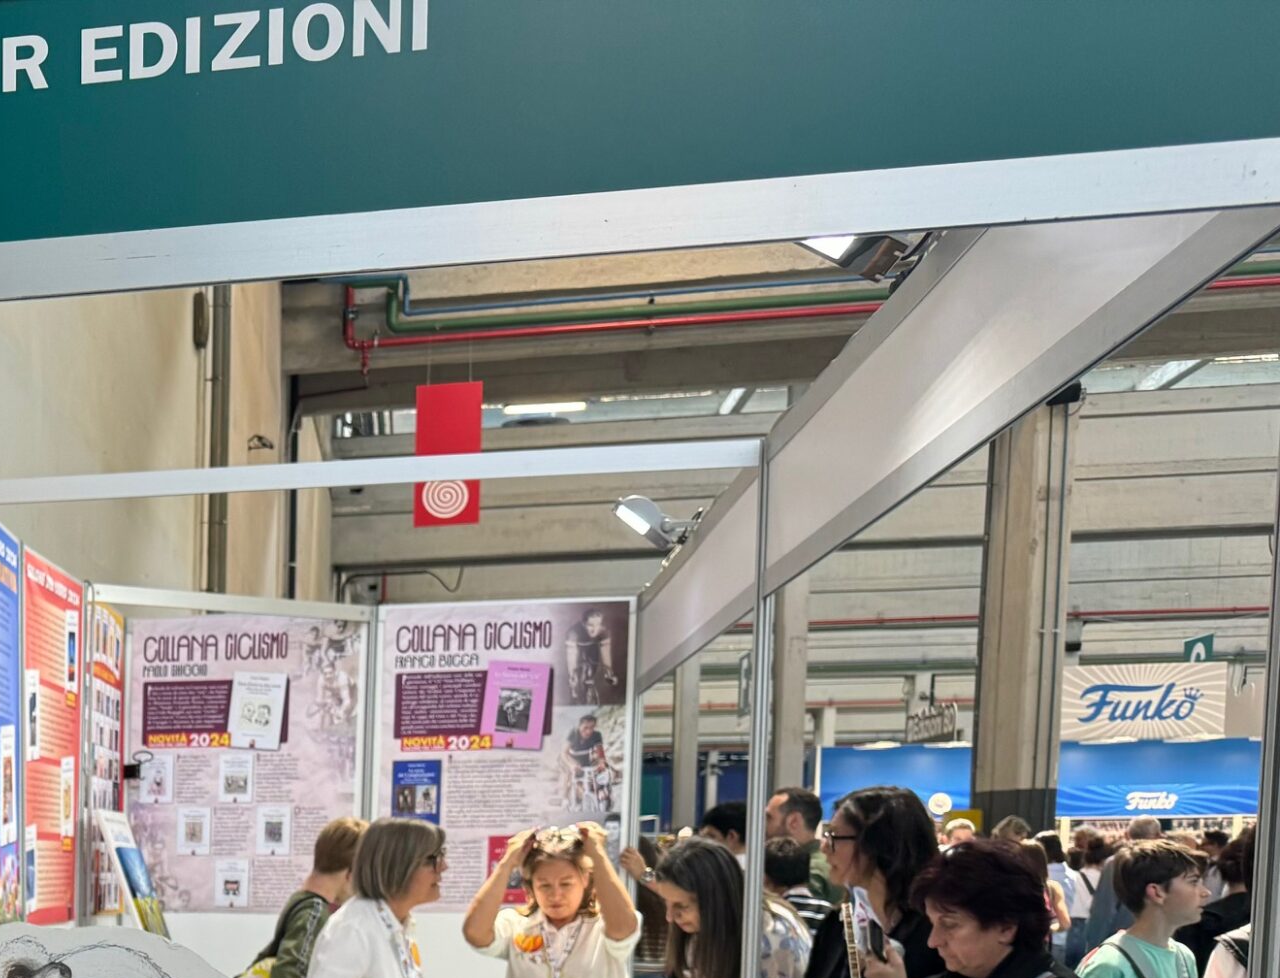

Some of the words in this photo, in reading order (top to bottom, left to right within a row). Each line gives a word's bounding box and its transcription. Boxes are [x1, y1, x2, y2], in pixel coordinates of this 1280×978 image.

[81, 0, 429, 85] EDIZIONI
[144, 634, 218, 663] COLLANA
[225, 632, 288, 660] CICLISMO
[396, 624, 477, 653] COLLANA
[484, 621, 552, 650] CICLISMO
[395, 655, 435, 669] FRANCO
[1078, 682, 1196, 723] Funko
[148, 734, 187, 743] NOVITÀ
[190, 733, 230, 746] 2024
[403, 736, 445, 747] NOVITÀ
[447, 736, 492, 749] 2024
[1125, 791, 1179, 810] Funko
